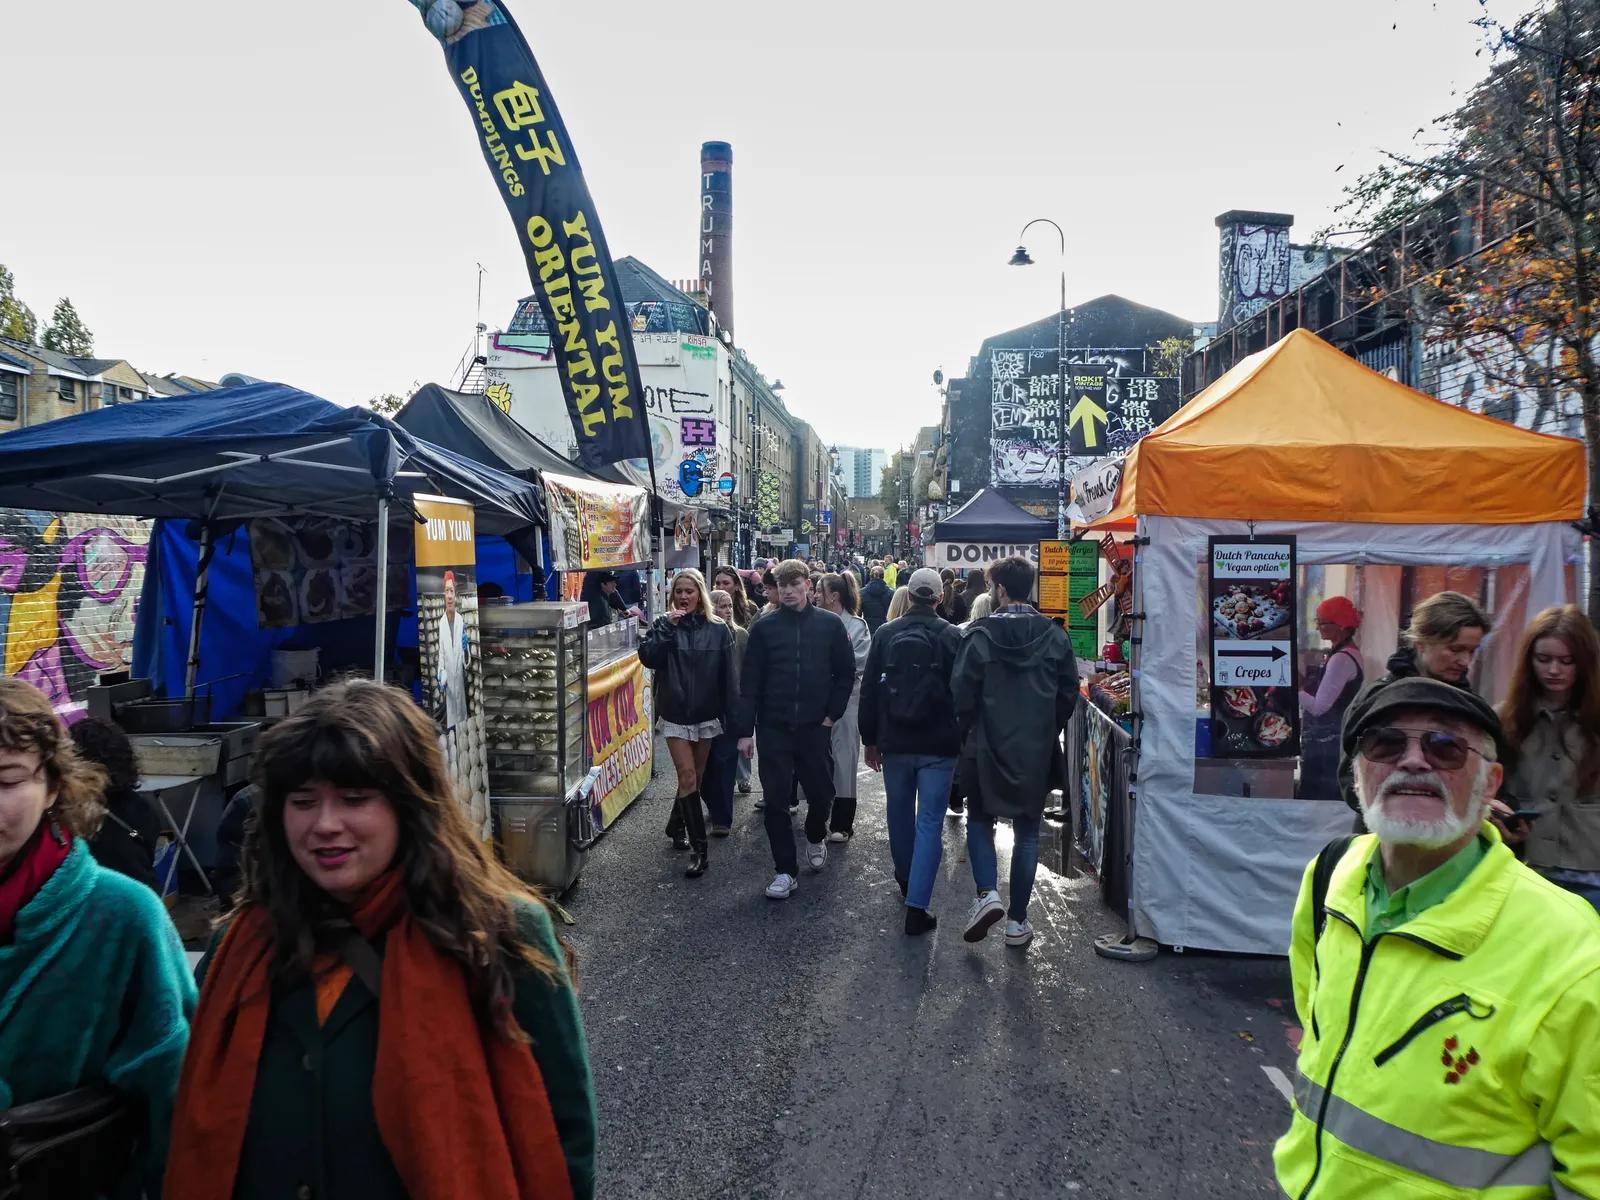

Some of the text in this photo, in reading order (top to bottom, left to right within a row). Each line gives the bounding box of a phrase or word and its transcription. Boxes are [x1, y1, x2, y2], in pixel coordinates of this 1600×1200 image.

[461, 66, 525, 197] DUMPLINGS
[493, 80, 566, 176] 包子
[526, 215, 607, 438] ORIENTAL
[563, 210, 634, 422] YUM YUM
[425, 518, 472, 542] YUM YUM
[1215, 550, 1290, 560] Dutch Pancakes
[1225, 562, 1279, 574] Vegan option
[1235, 665, 1272, 681] Crepes
[621, 728, 651, 778] FOODS
